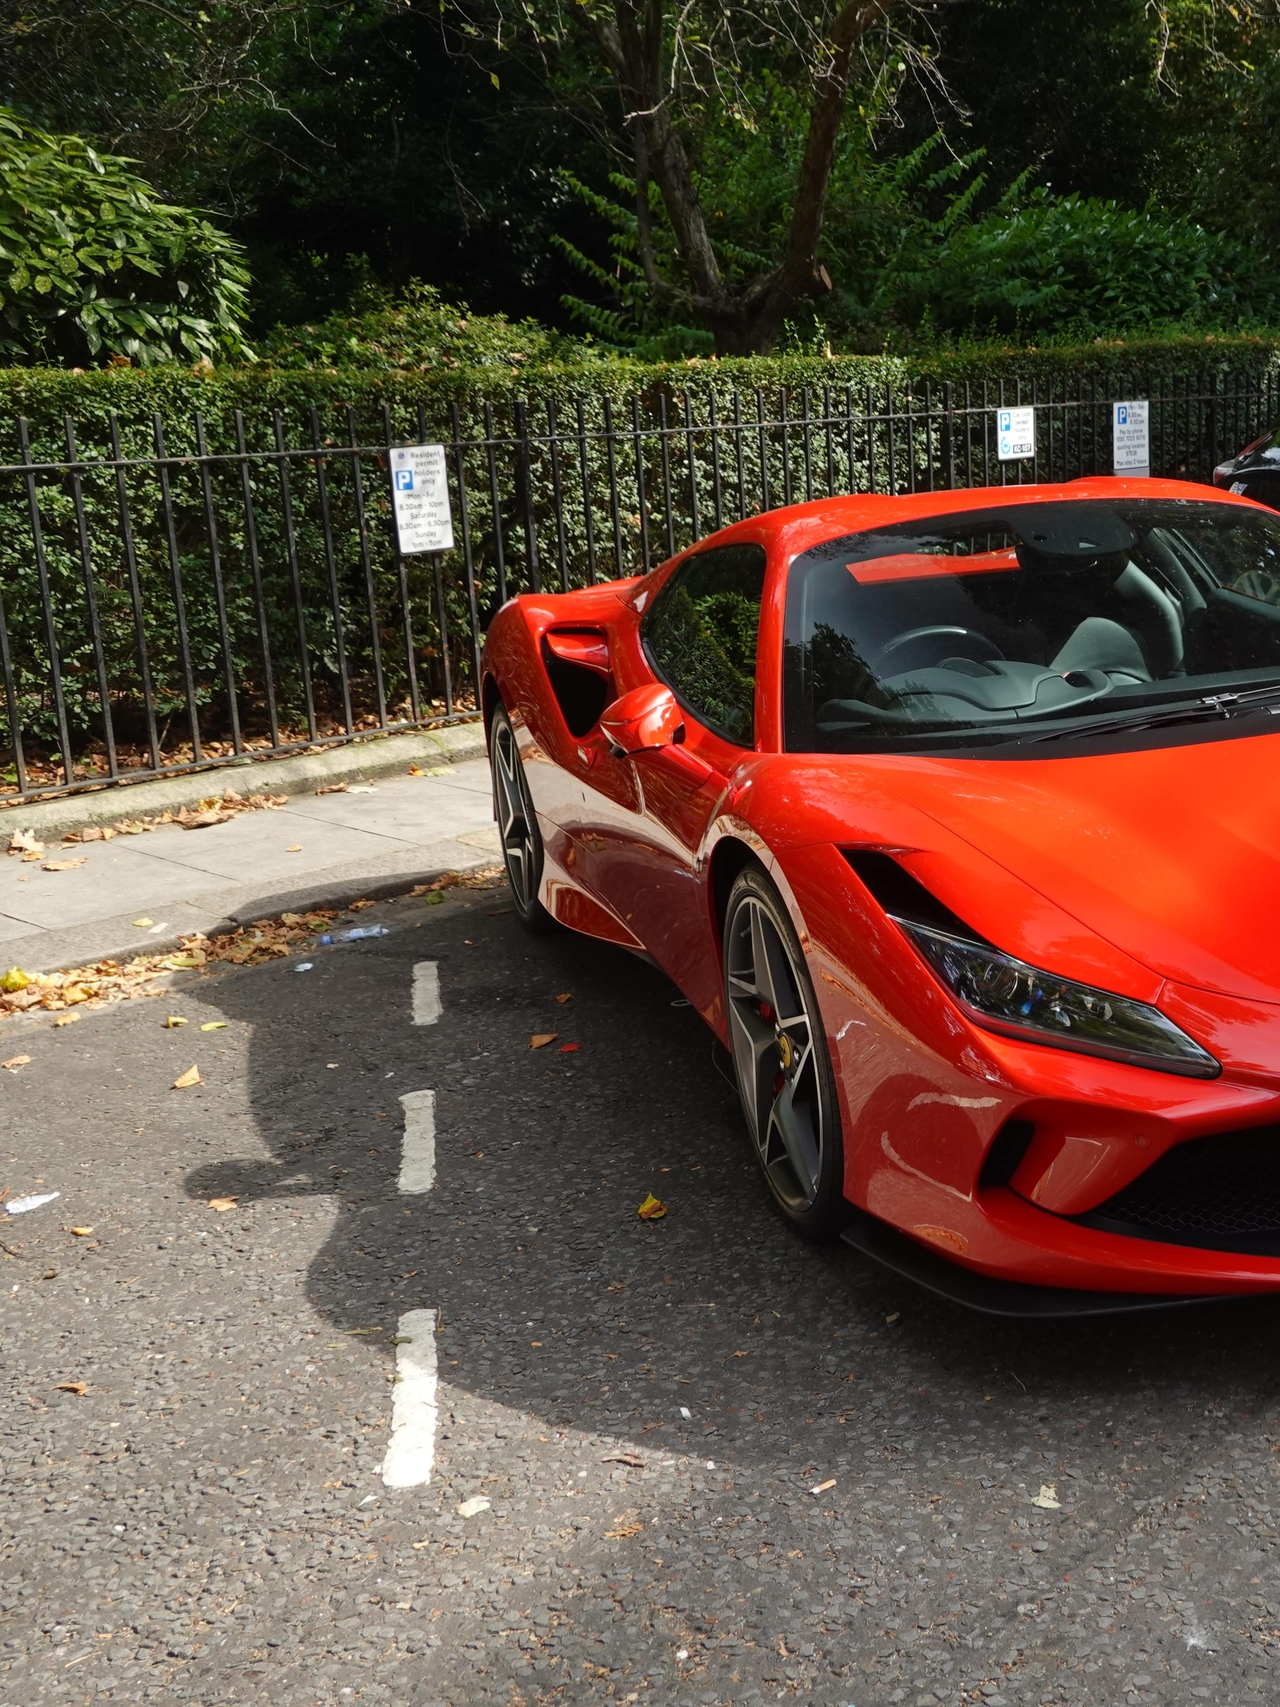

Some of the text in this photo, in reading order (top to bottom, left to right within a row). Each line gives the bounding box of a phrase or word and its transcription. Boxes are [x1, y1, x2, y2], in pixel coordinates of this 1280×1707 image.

[410, 451, 441, 459] Resident
[415, 460, 438, 468] permit
[410, 511, 437, 519] Saturday
